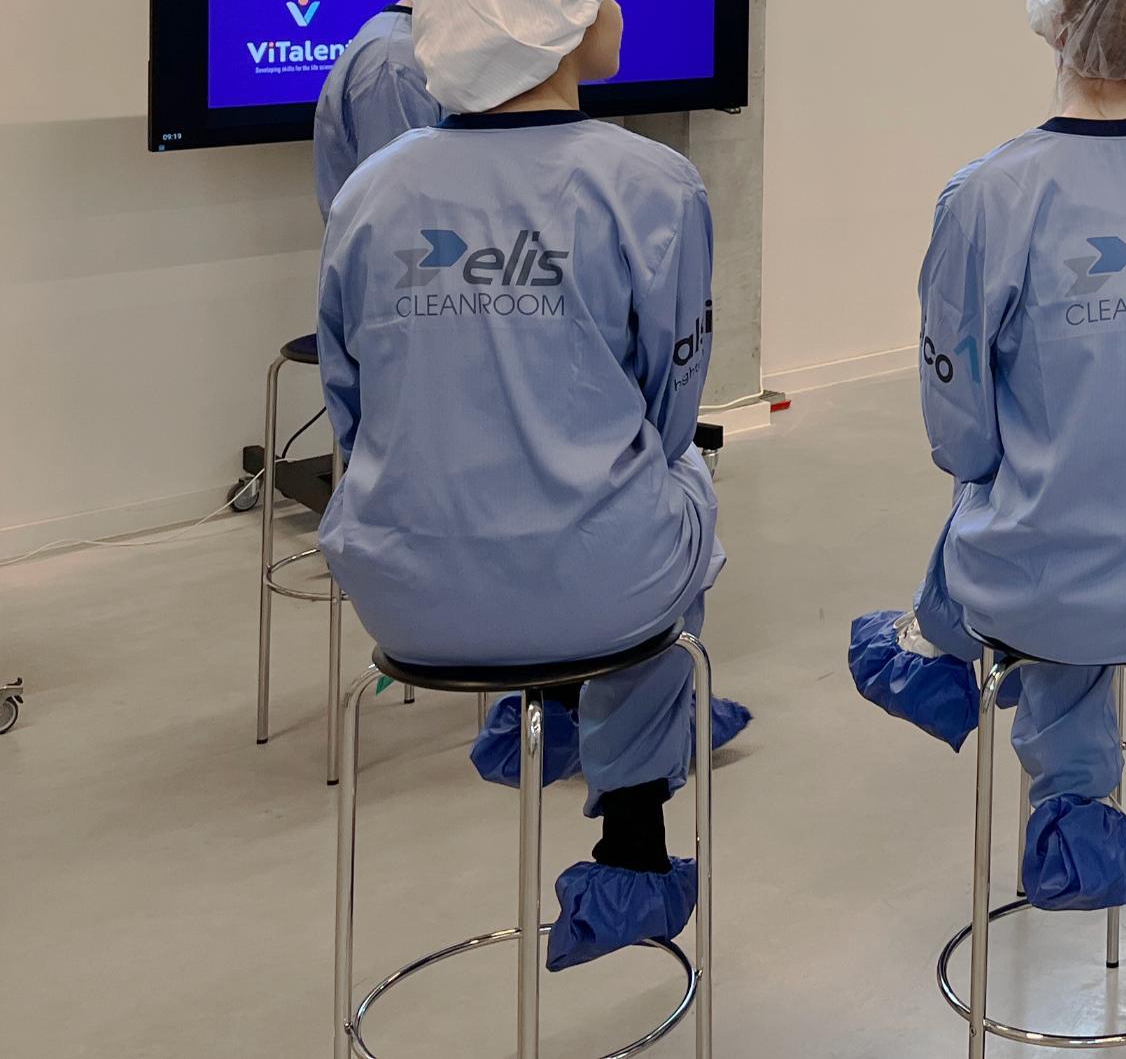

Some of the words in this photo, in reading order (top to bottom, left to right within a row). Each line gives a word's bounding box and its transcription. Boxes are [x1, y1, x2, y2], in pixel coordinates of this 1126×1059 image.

[162, 132, 182, 141] 09:19
[462, 229, 569, 287] elis
[396, 292, 565, 318] CLEANROOM
